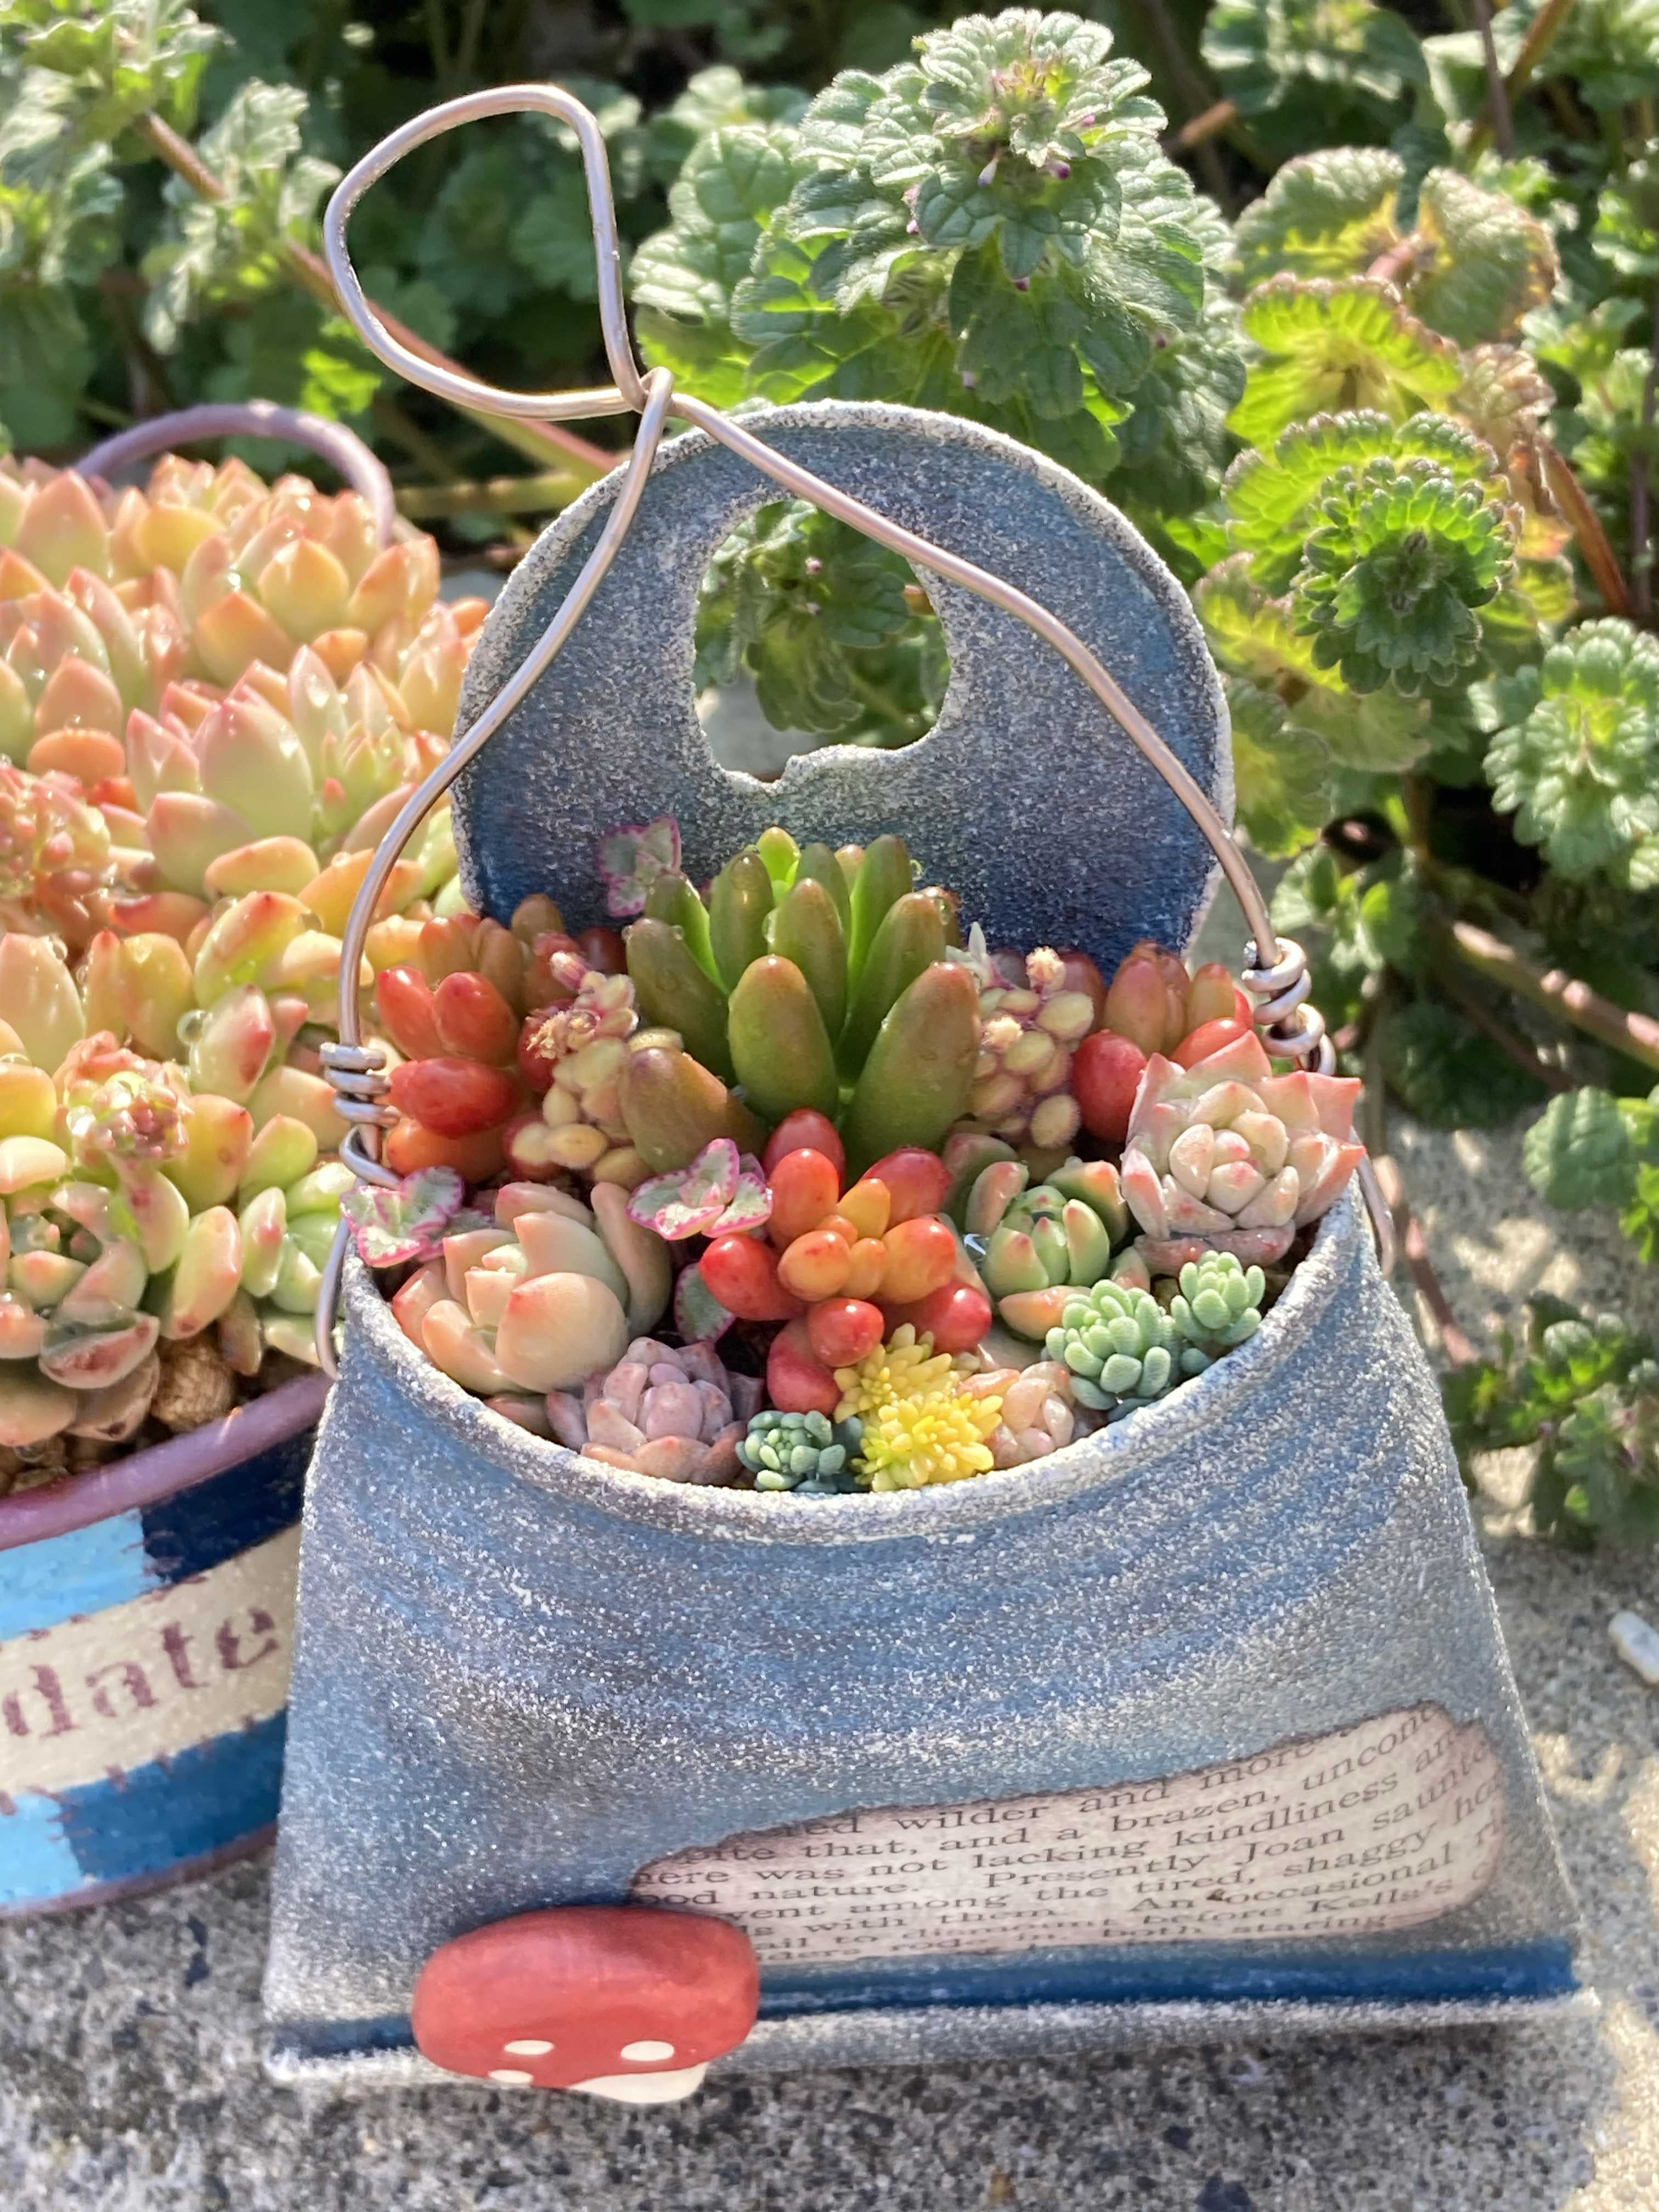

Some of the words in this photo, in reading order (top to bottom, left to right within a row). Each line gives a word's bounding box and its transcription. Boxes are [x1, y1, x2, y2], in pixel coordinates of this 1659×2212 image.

[753, 1868, 845, 1880] was
[869, 1859, 949, 1876] not
[973, 1839, 1150, 1869] lacking
[1172, 1773, 1398, 1847] kindliness
[802, 1839, 918, 1858] that,
[939, 1827, 1030, 1851] and
[1056, 1828, 1085, 1841] a
[1111, 1790, 1280, 1832] brazen,
[893, 1806, 1049, 1830] wilder
[1079, 1778, 1170, 1813] and
[1199, 1740, 1316, 1791] more
[752, 1884, 919, 1899] nature.
[983, 1854, 1210, 1887] Presently
[1233, 1828, 1345, 1865] Joan
[804, 1917, 906, 1932] with
[1127, 1898, 1194, 1912] An
[1224, 1841, 1454, 1904] occasional
[850, 1895, 1010, 1913] among
[1036, 1887, 1109, 1900] the
[1135, 1869, 1256, 1893] tired,
[1283, 1821, 1437, 1877] shaggy
